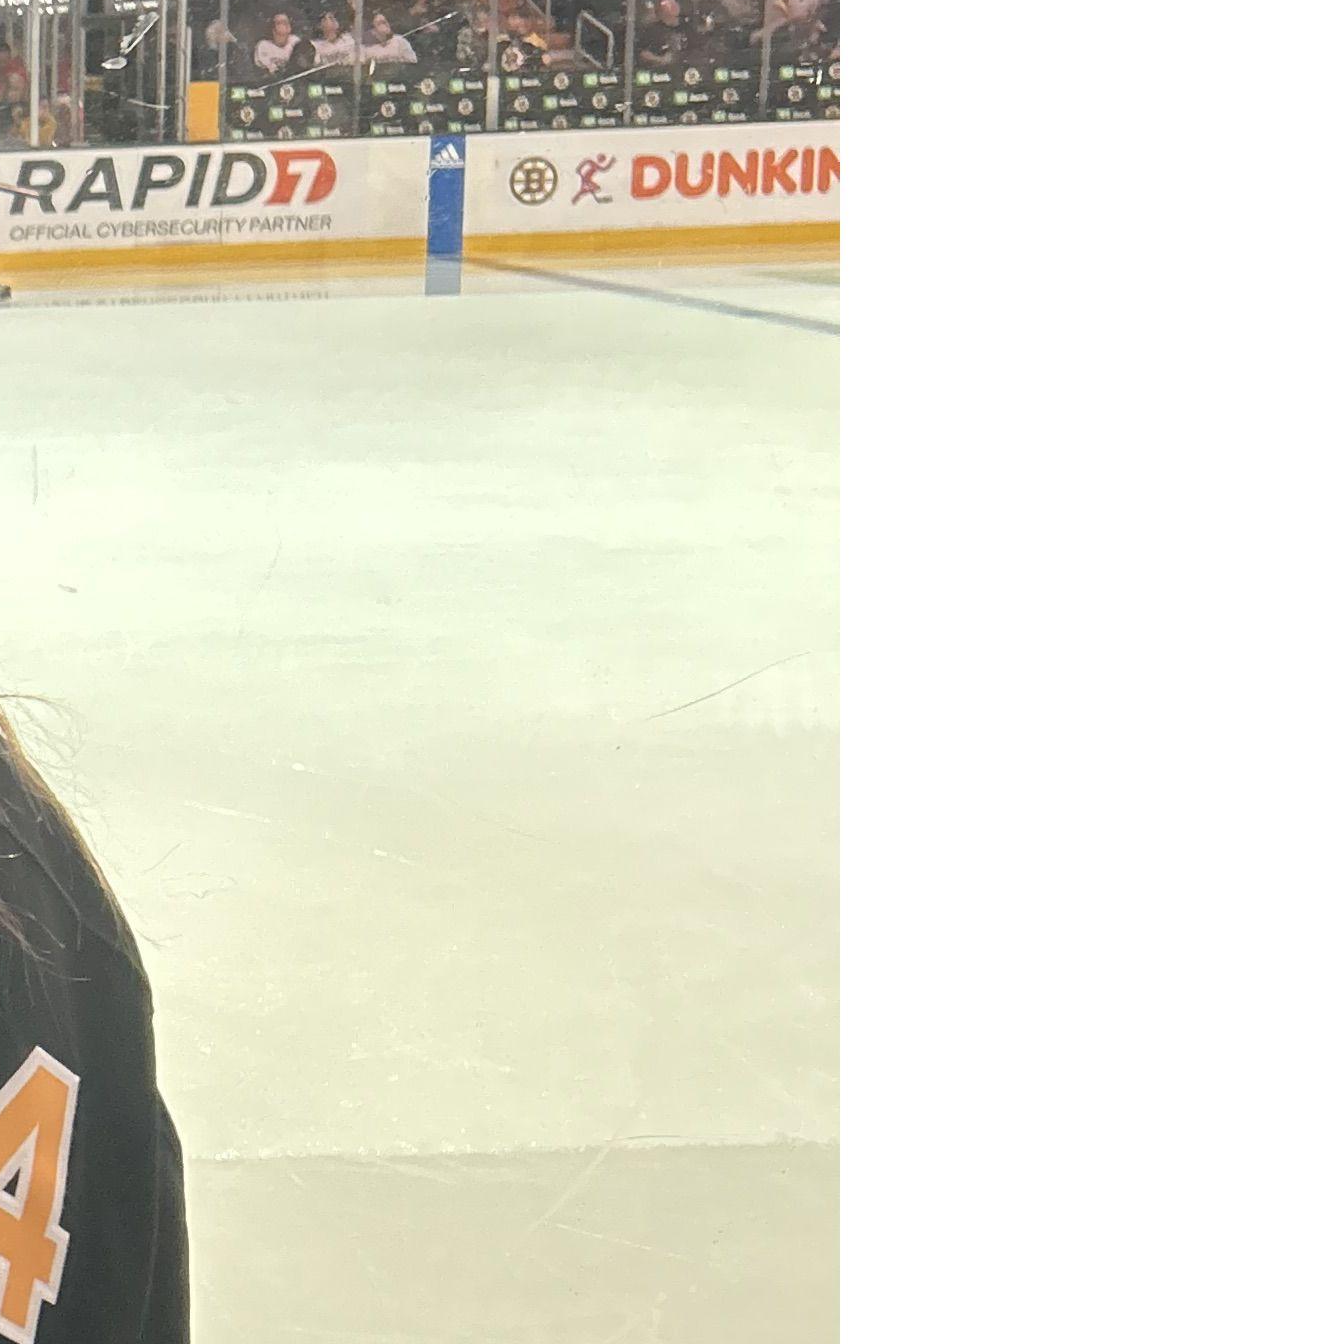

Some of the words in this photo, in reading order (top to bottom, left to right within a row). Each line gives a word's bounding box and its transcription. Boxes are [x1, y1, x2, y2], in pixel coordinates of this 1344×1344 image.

[8, 147, 337, 216] RAPID7
[9, 222, 92, 242] OFFICIAL
[97, 216, 248, 239] CYBERSECURITY
[249, 213, 333, 233] PARTNER
